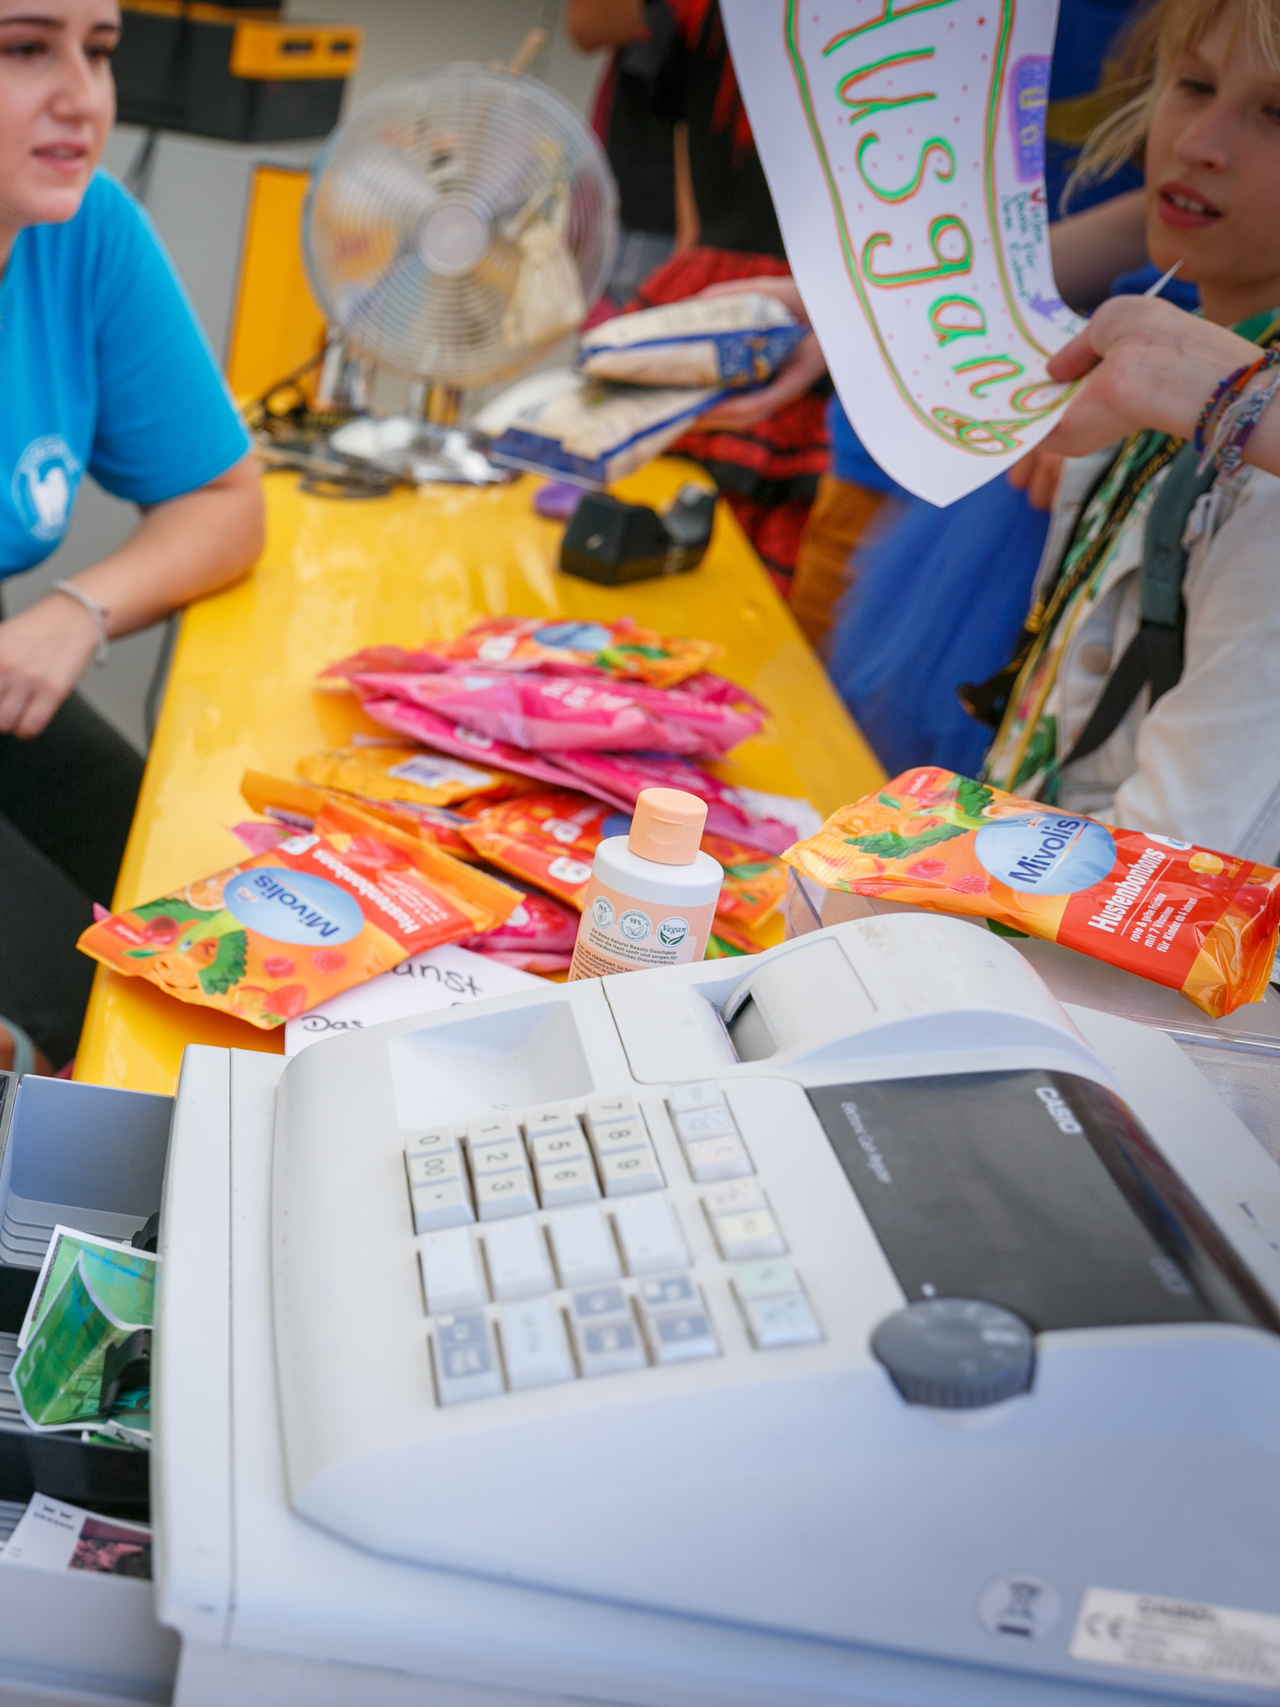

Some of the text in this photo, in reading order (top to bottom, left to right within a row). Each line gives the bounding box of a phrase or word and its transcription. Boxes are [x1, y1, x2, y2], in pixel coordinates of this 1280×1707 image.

[1008, 819, 1081, 884] Mivolis
[311, 849, 421, 935] Hustenbonbons
[1088, 847, 1166, 934] Hustenbonbons
[253, 874, 340, 938] Mivolis
[662, 924, 687, 935] Vegan
[1130, 927, 1144, 943] rote
[1149, 927, 1160, 935] 7
[1162, 921, 1181, 942] Kinder
[1144, 934, 1157, 948] mit
[1156, 940, 1170, 953] für
[629, 944, 649, 953] Beauty
[383, 961, 485, 998] unst
[600, 1101, 624, 1112] 7
[1036, 1086, 1083, 1135] CASIO
[539, 1112, 559, 1123] 4
[419, 1134, 440, 1145] 0
[608, 1128, 632, 1141] 8
[547, 1139, 572, 1153] 5
[486, 1151, 510, 1163] 2
[616, 1157, 641, 1170] 9
[423, 1157, 446, 1177] 00
[553, 1169, 578, 1182] 6
[491, 1180, 515, 1193] 3
